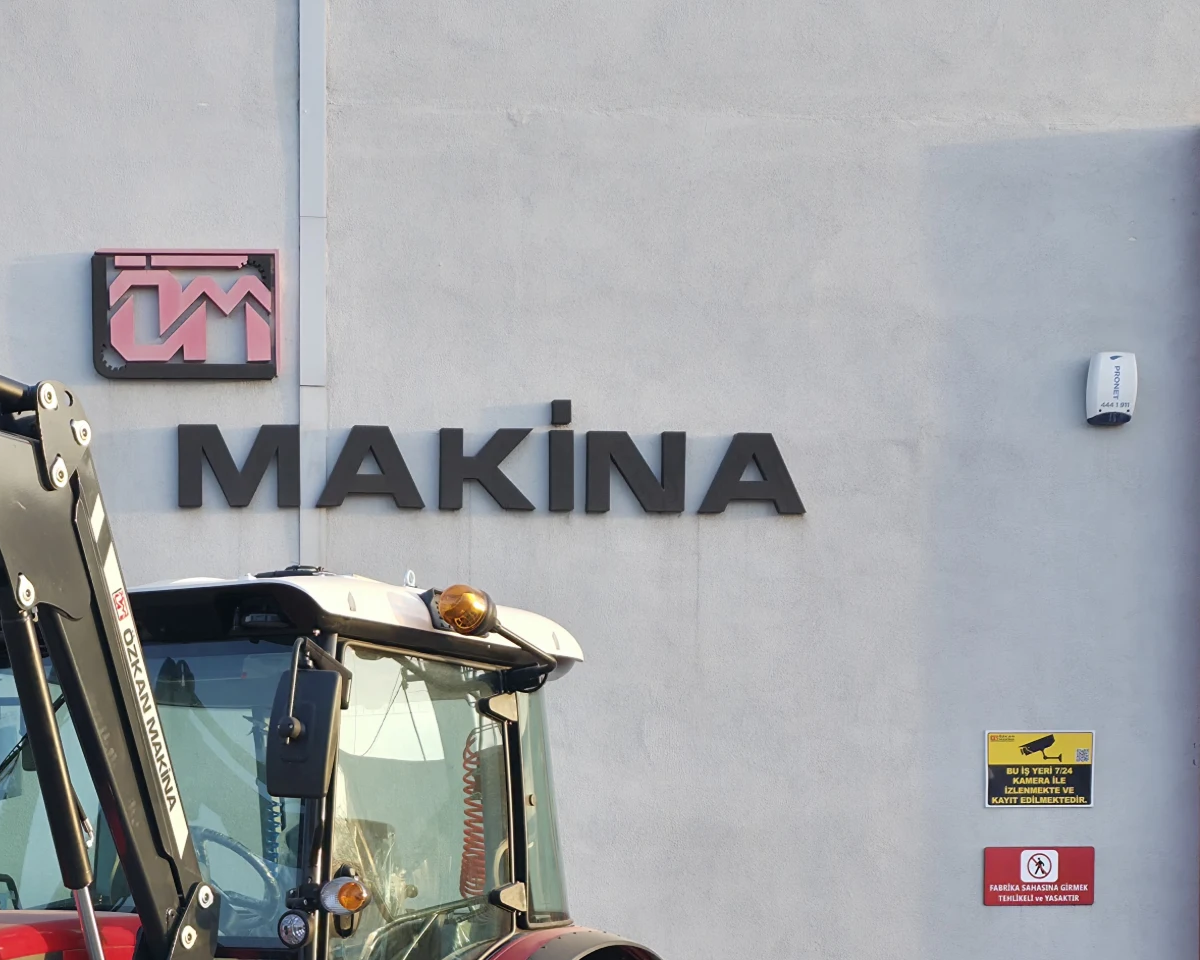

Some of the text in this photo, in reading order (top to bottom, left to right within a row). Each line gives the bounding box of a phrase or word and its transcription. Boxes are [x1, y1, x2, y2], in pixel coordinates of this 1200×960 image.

[1113, 365, 1121, 400] PRONET
[178, 399, 807, 515] MAKİNA
[122, 628, 177, 813] ÖZKAN MAKİNA
[1006, 766, 1073, 776] BU İŞ YERİ 7/24
[1052, 776, 1066, 784] İLE
[1004, 786, 1061, 794] İZLENMEKTE
[991, 795, 1087, 804] KAYIT EDİLMEKTEDİR.
[989, 883, 1020, 891] FABRİKA
[1060, 883, 1088, 891] GİRMEK
[999, 894, 1034, 902] TEHLİKELİ
[1045, 894, 1080, 902] YASAKTIR
